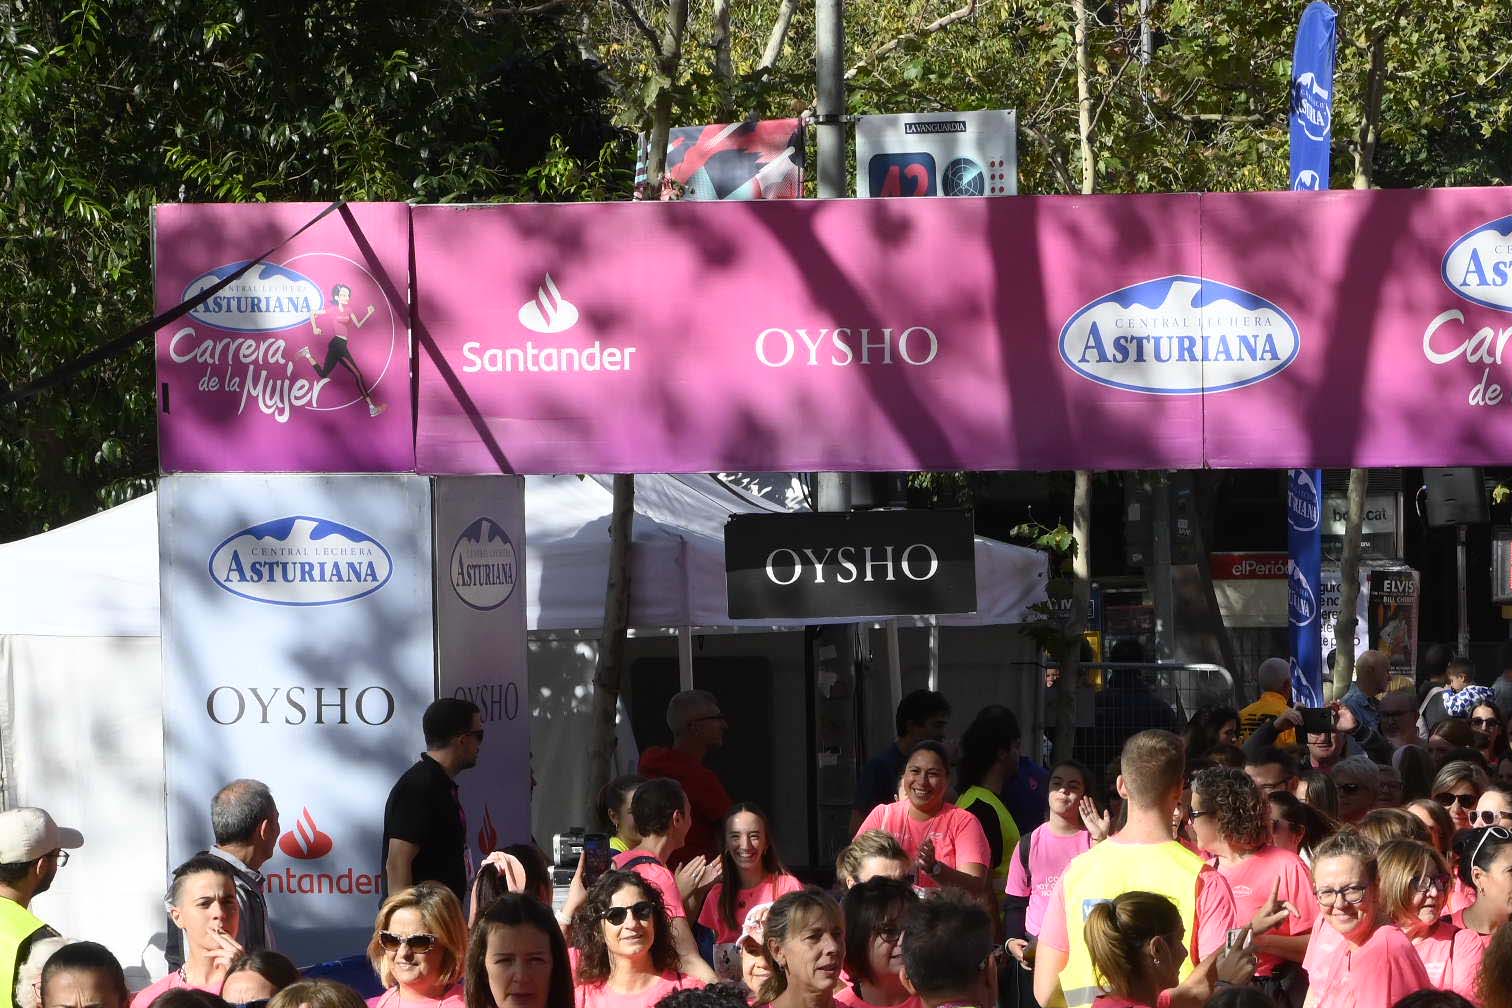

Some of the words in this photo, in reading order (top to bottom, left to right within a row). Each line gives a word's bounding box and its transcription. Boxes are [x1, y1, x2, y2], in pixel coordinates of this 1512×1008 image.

[169, 326, 287, 365] Carrera
[462, 340, 636, 373] Santander
[754, 326, 939, 368] OYSHO
[1078, 320, 1282, 364] ASTURIANA
[198, 366, 221, 392] de
[224, 366, 241, 392] la
[237, 361, 331, 423] Mujer
[1468, 367, 1502, 406] de
[223, 549, 380, 584] ASTURIANA
[250, 546, 309, 557] CENTRAL
[314, 547, 374, 557] LECHERA
[455, 551, 514, 587] ASTURIANA
[764, 543, 939, 586] OYSHO
[1383, 580, 1415, 593] ELVIS
[206, 685, 396, 726] OYSHO
[262, 867, 383, 894] ntander
